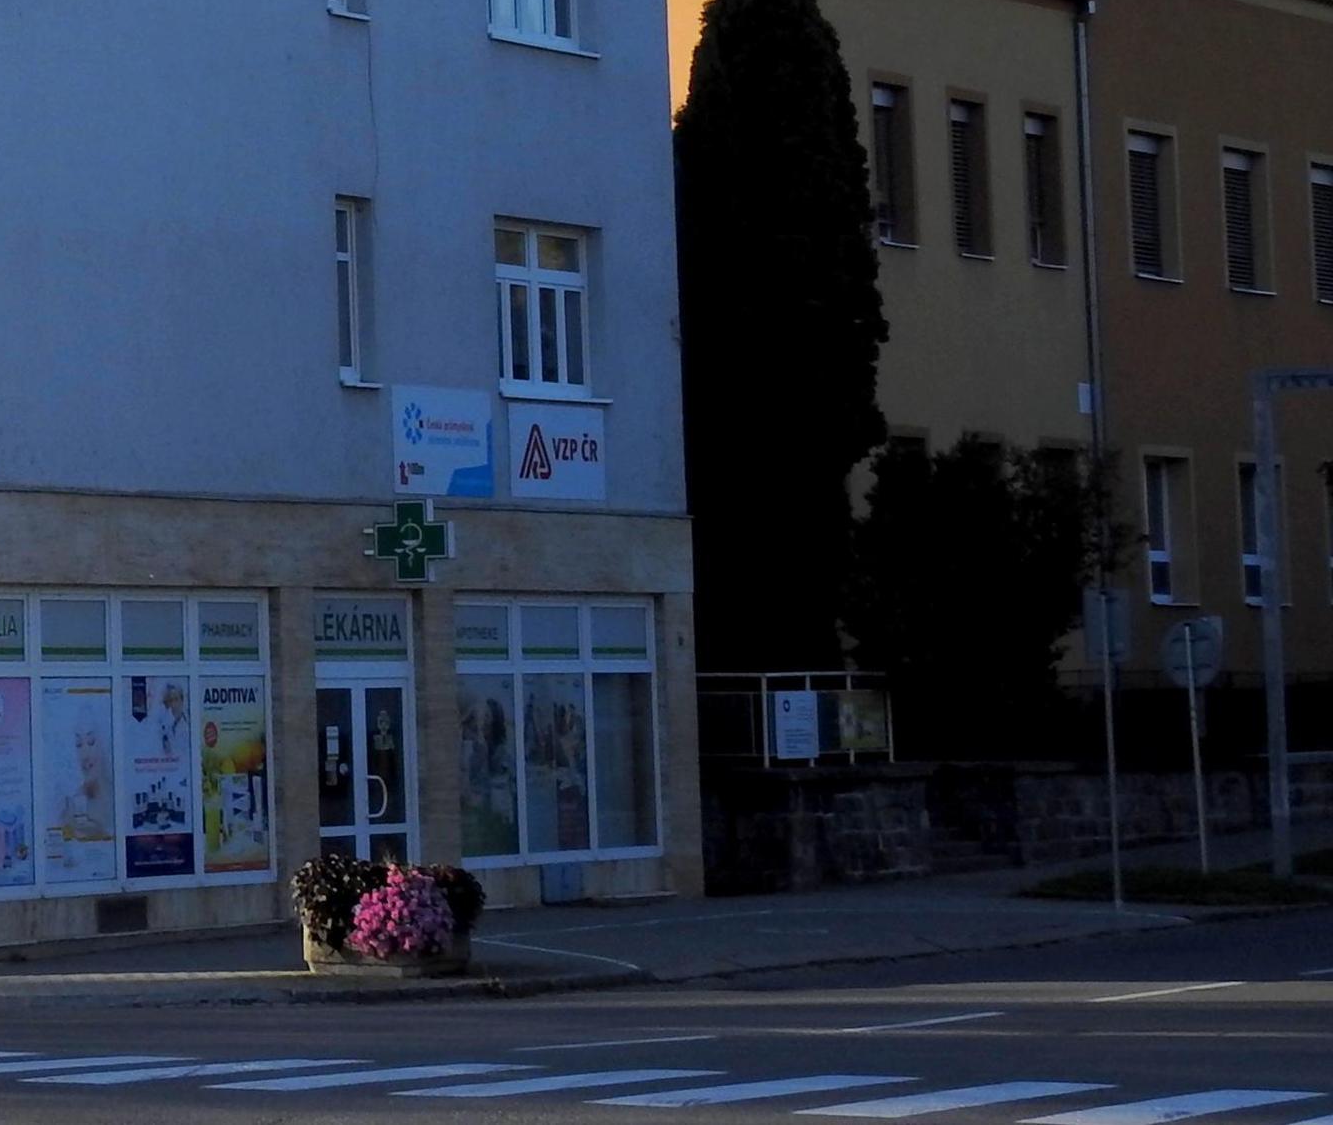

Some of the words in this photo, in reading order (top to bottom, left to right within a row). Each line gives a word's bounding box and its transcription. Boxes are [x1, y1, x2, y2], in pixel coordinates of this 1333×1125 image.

[552, 437, 578, 462] VZP
[581, 433, 598, 463] ČR
[202, 622, 253, 636] PHARMACY
[314, 604, 402, 642] LÉKÁRNA
[203, 687, 256, 704] ADDITIVA
